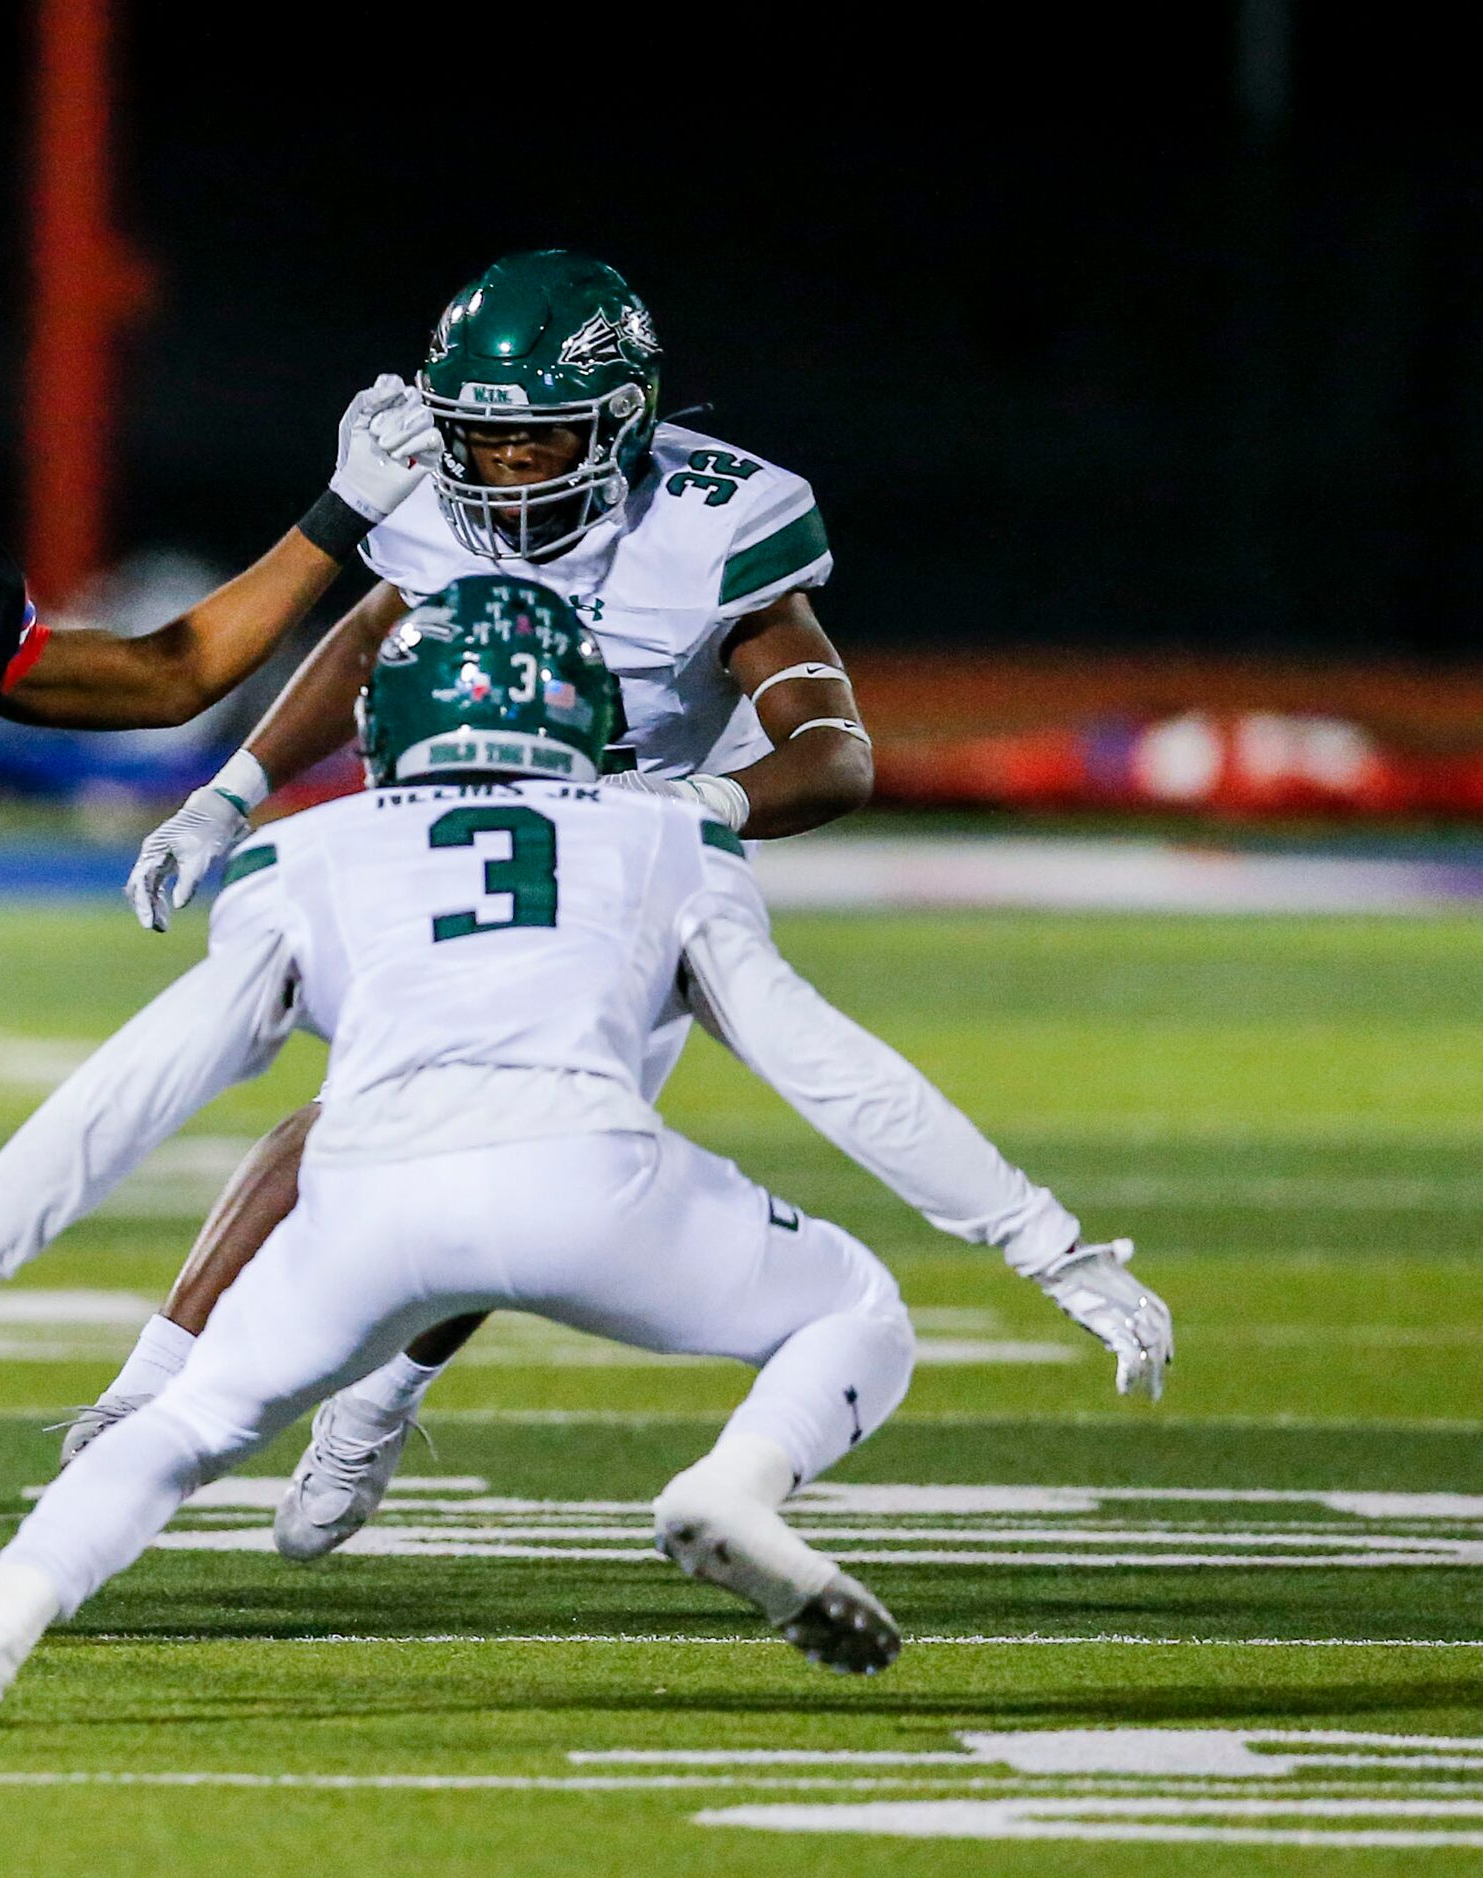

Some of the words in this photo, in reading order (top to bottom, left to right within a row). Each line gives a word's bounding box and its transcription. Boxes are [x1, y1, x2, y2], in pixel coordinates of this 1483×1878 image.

[666, 449, 764, 507] 32
[508, 652, 537, 703] 3
[429, 806, 558, 943] 3
